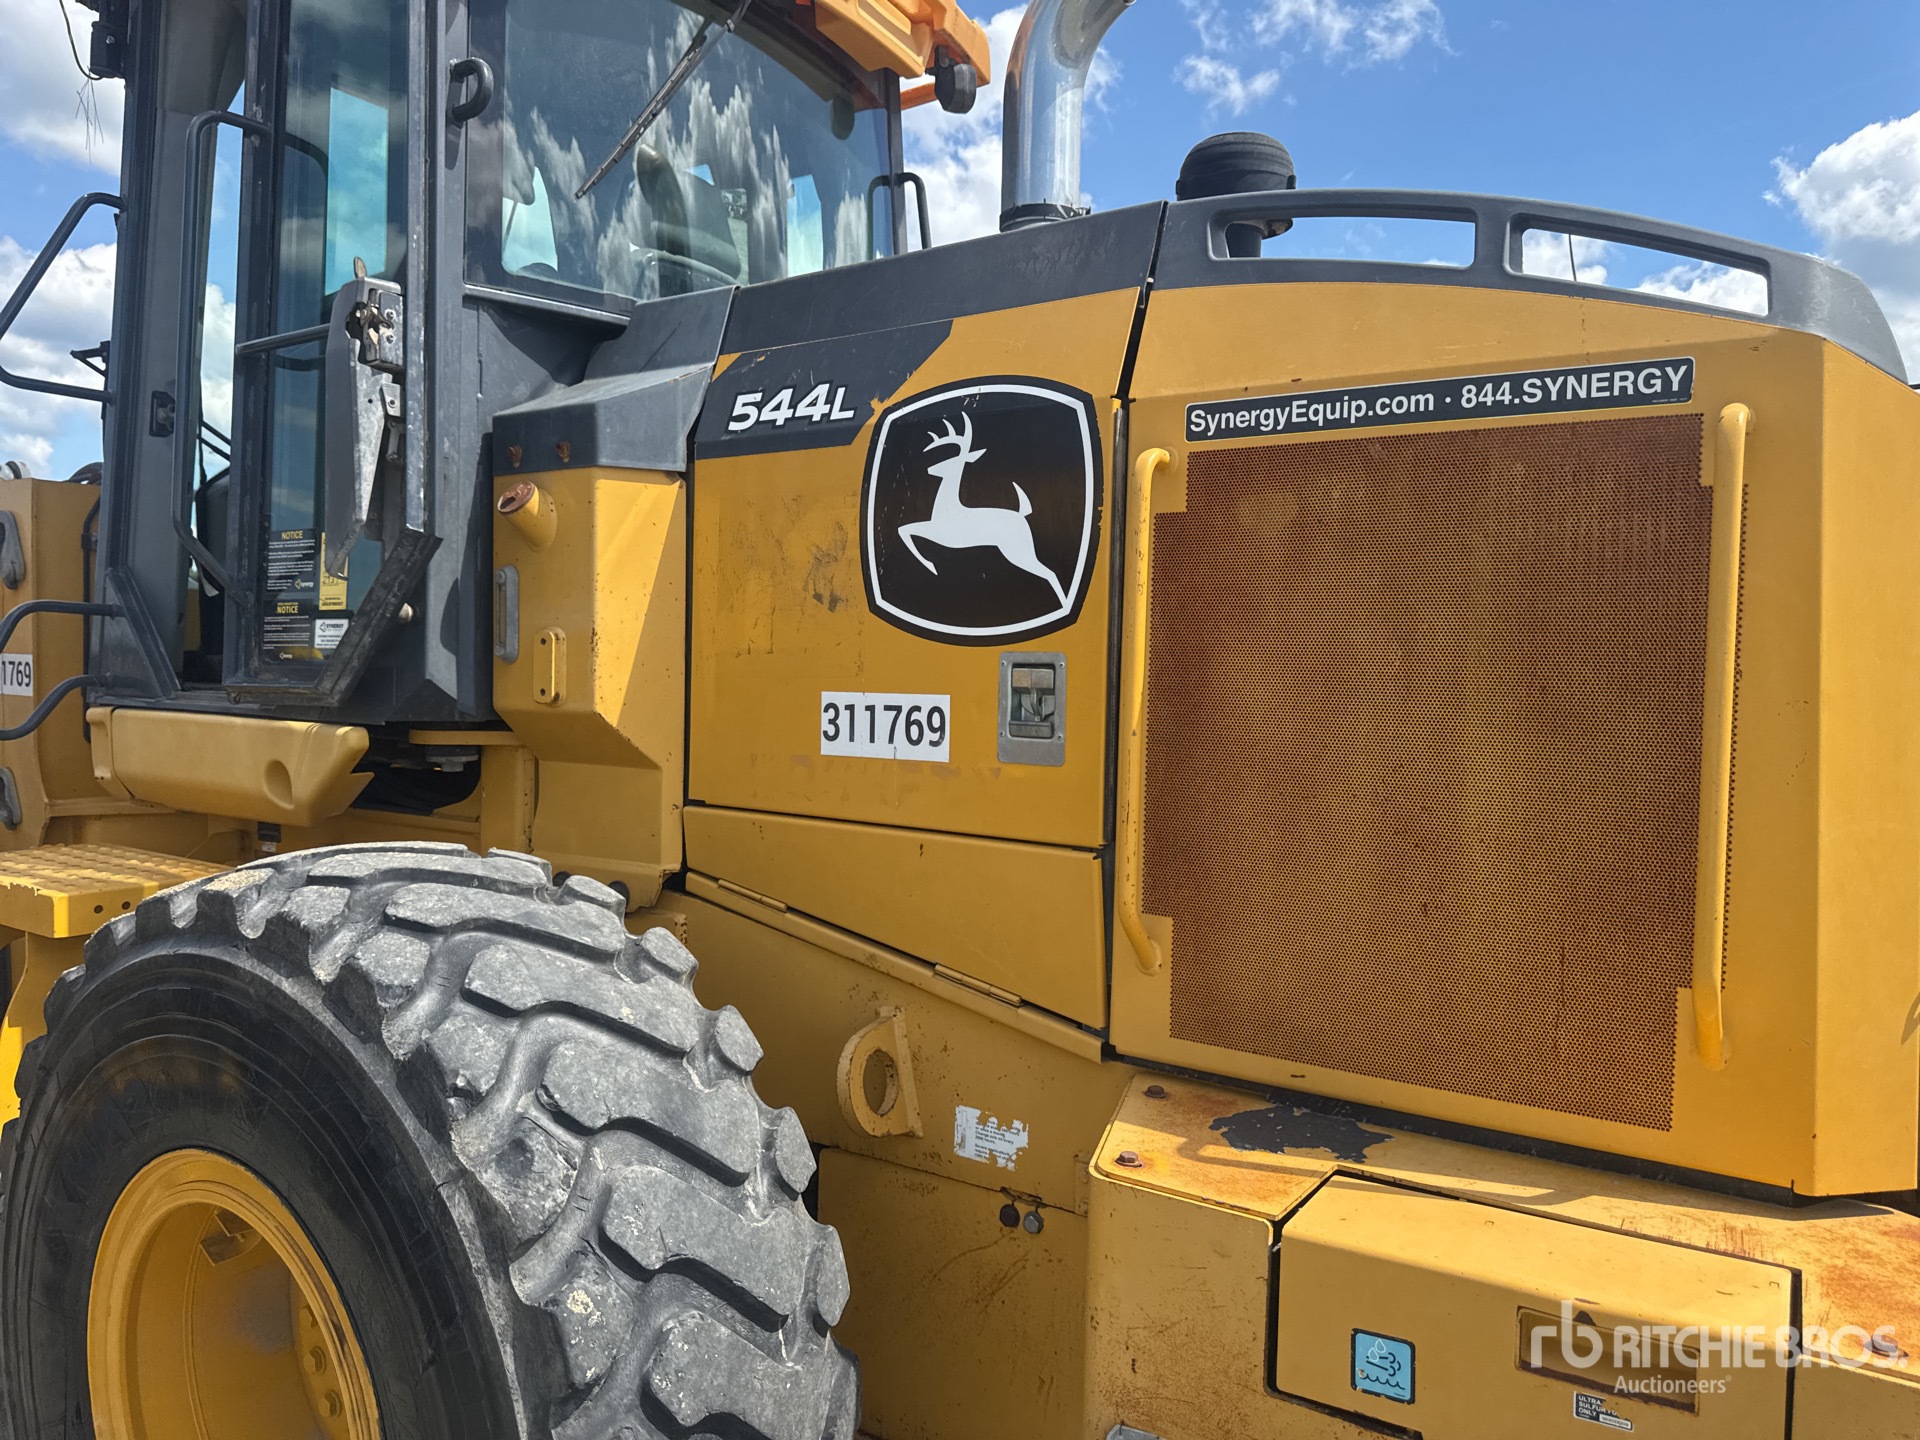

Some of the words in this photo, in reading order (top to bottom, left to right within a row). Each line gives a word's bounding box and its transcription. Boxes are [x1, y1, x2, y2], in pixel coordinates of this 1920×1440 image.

[1189, 392, 1434, 437] SynergyEquip.com
[1461, 364, 1688, 409] 844.SYNERGY
[727, 382, 855, 431] 544L
[281, 530, 304, 540] NOTICE
[276, 605, 299, 614] NOTICE
[822, 701, 946, 748] 311769
[1578, 1394, 1602, 1405] ULTRA
[1578, 1407, 1597, 1417] ONLY
